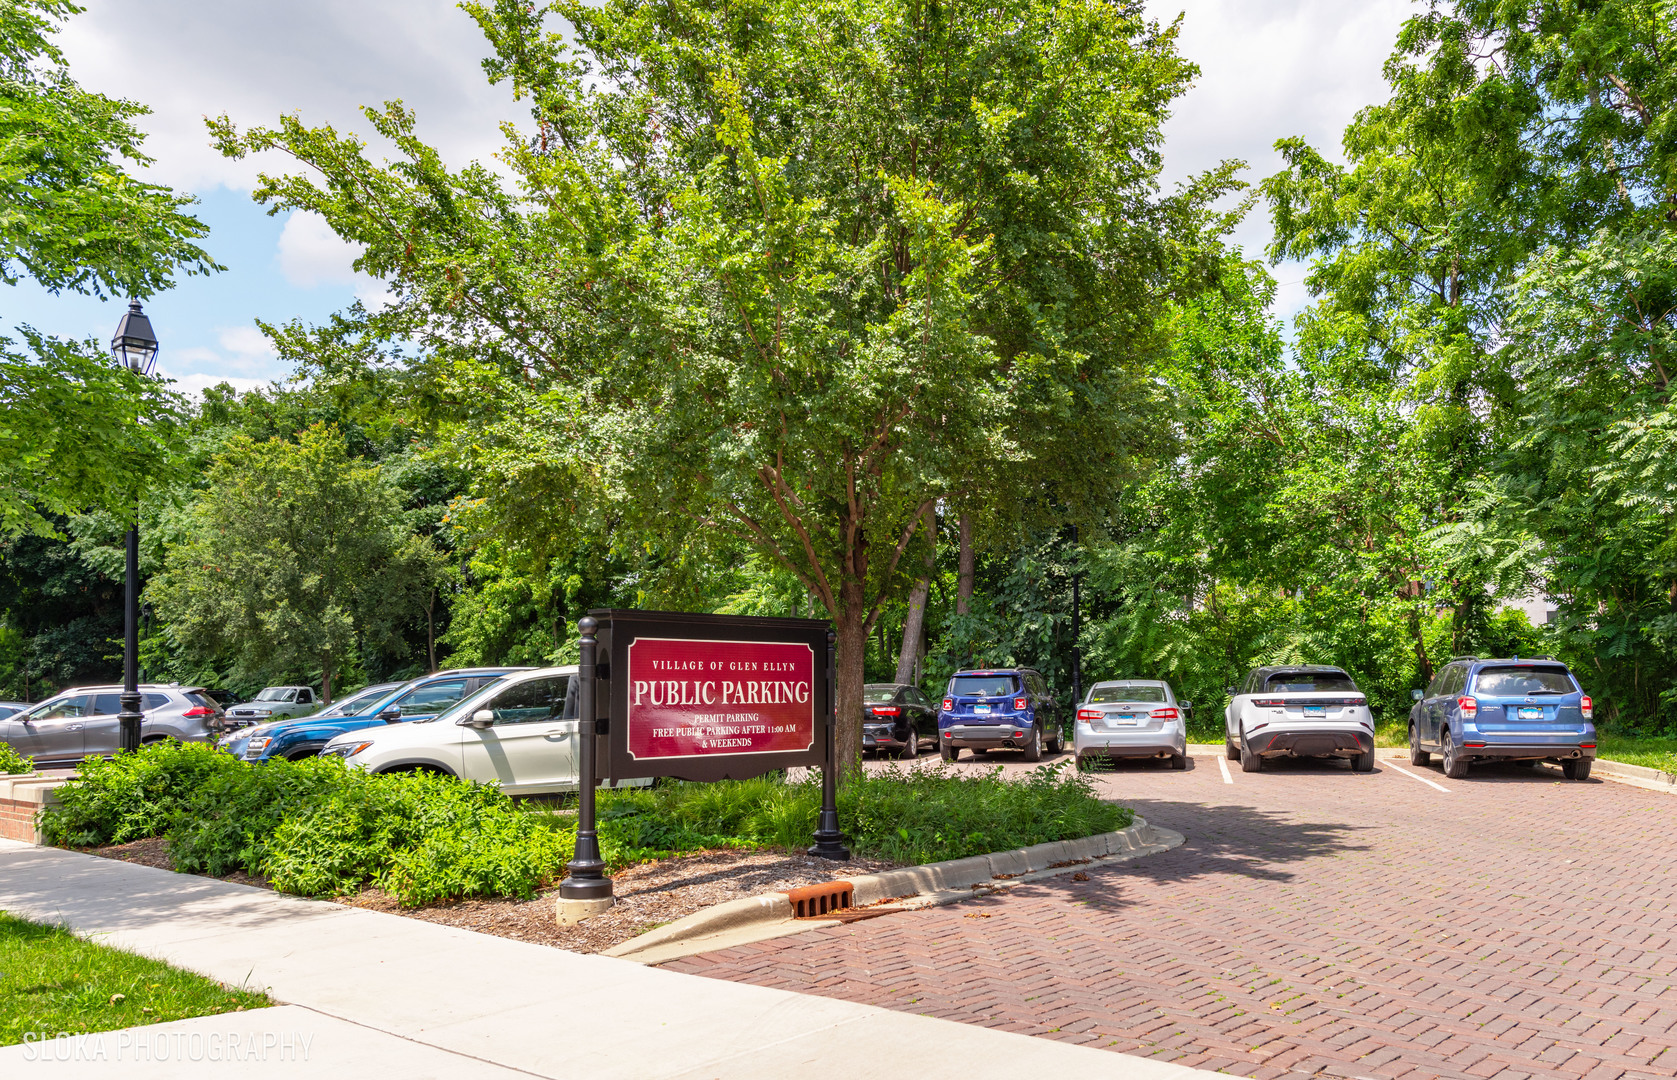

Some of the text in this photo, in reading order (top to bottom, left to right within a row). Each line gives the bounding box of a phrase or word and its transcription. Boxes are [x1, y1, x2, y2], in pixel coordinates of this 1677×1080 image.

[652, 660, 796, 671] VILLAGE OF GLEN ELLYN
[633, 680, 810, 706] PUBLIC PARKING
[694, 713, 759, 724] PERMIT PARKING
[652, 724, 796, 738] FREE PUBLIC PARKING AFTER 11:00 AM
[701, 737, 752, 748] & WEEKENDS
